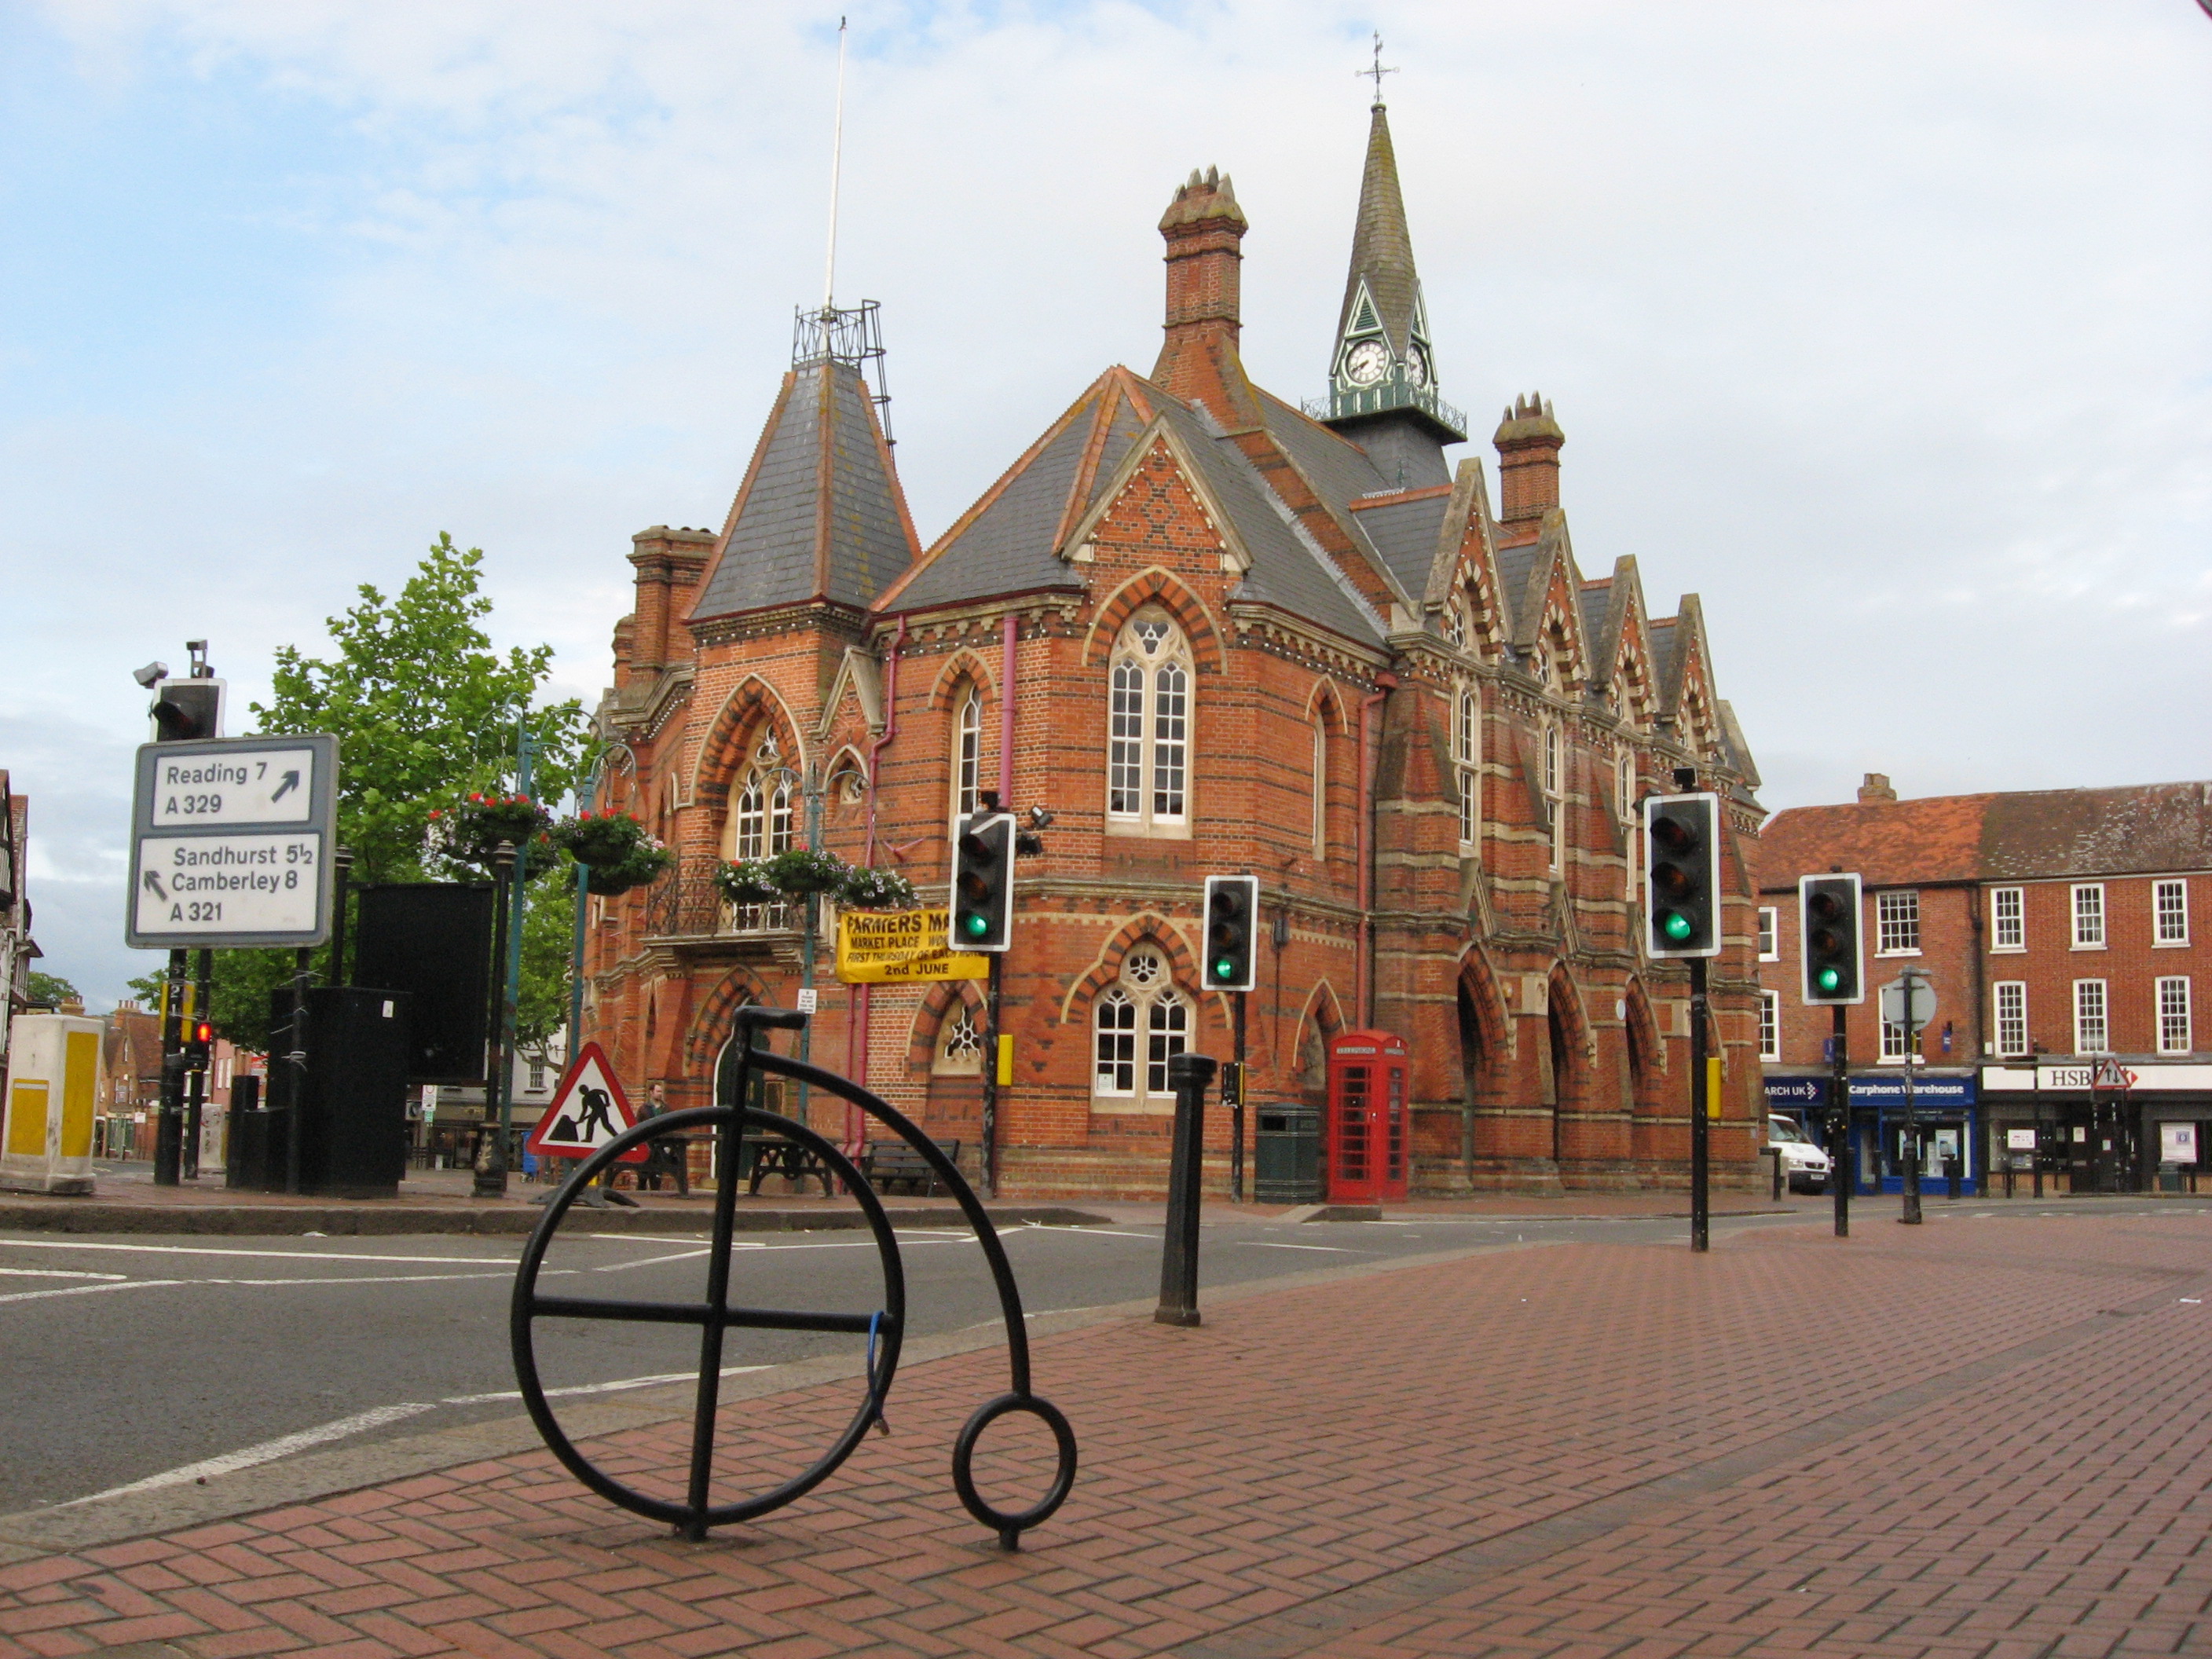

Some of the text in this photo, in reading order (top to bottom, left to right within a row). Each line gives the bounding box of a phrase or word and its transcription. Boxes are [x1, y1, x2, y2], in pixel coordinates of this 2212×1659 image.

[167, 762, 268, 786] Reading 7
[173, 846, 277, 866] Sandhurst
[171, 870, 298, 893] Camberley 8
[847, 913, 950, 934] FARMERS MA
[851, 937, 884, 950] MARKET
[888, 936, 920, 949] PLACE
[884, 963, 950, 976] 2nd JUNE
[2051, 1070, 2092, 1086] HSB
[1764, 1086, 1807, 1096] ARCH UK
[1848, 1085, 1900, 1097] Carphone
